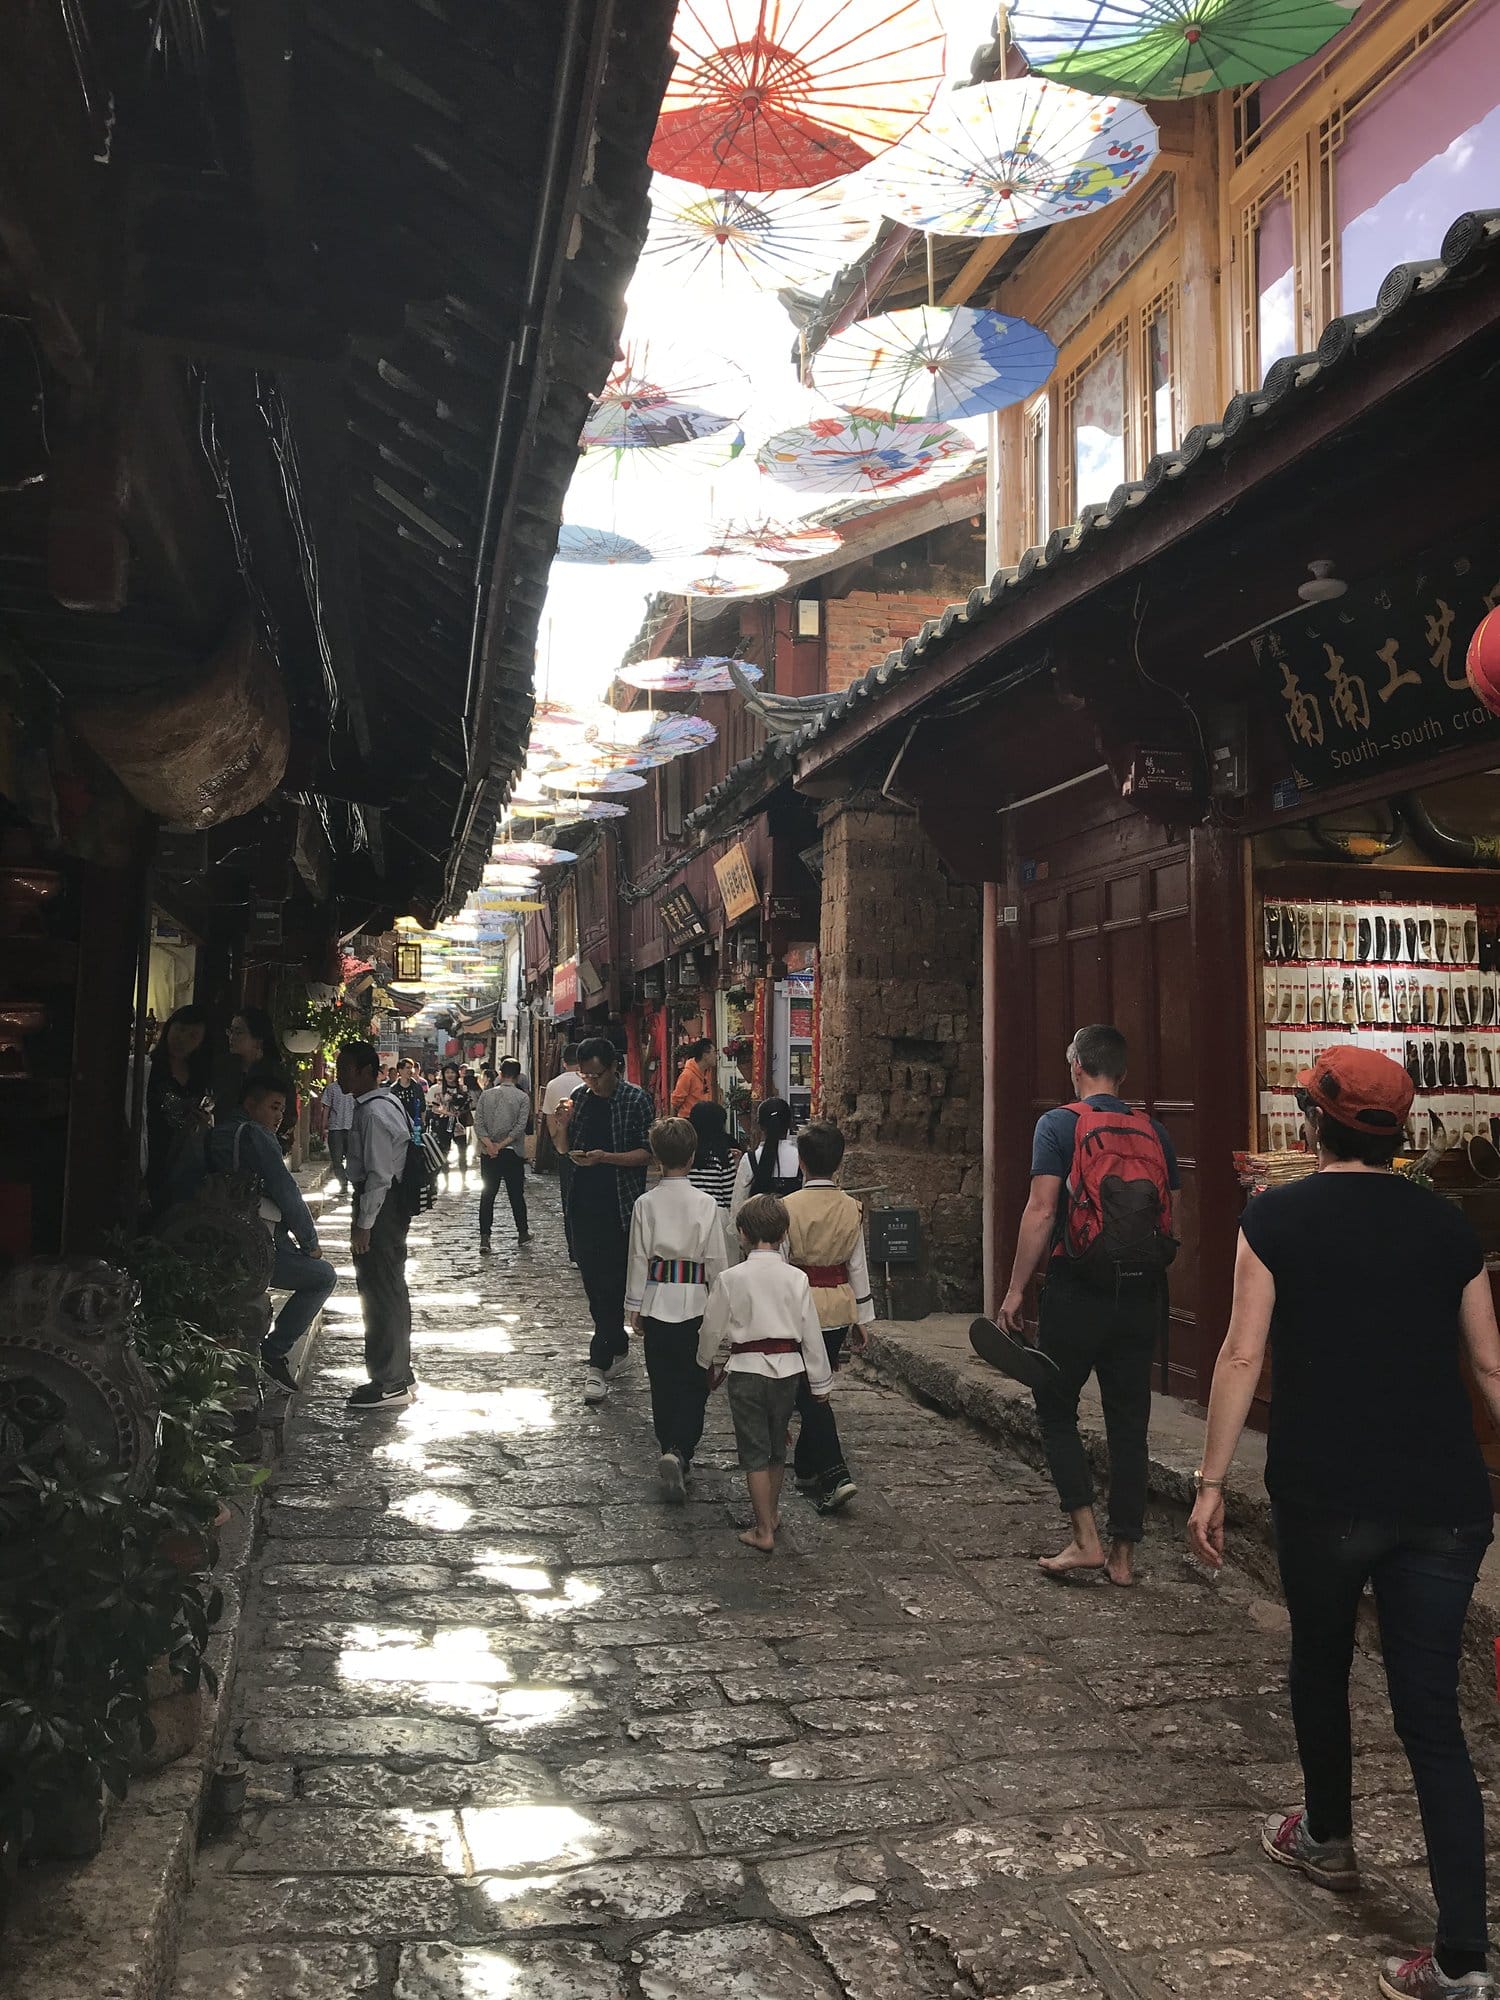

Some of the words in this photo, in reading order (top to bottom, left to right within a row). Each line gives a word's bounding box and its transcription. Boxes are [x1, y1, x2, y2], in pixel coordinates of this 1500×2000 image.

[1279, 580, 1500, 748] 南南工艺
[1330, 717, 1444, 769] South-south
